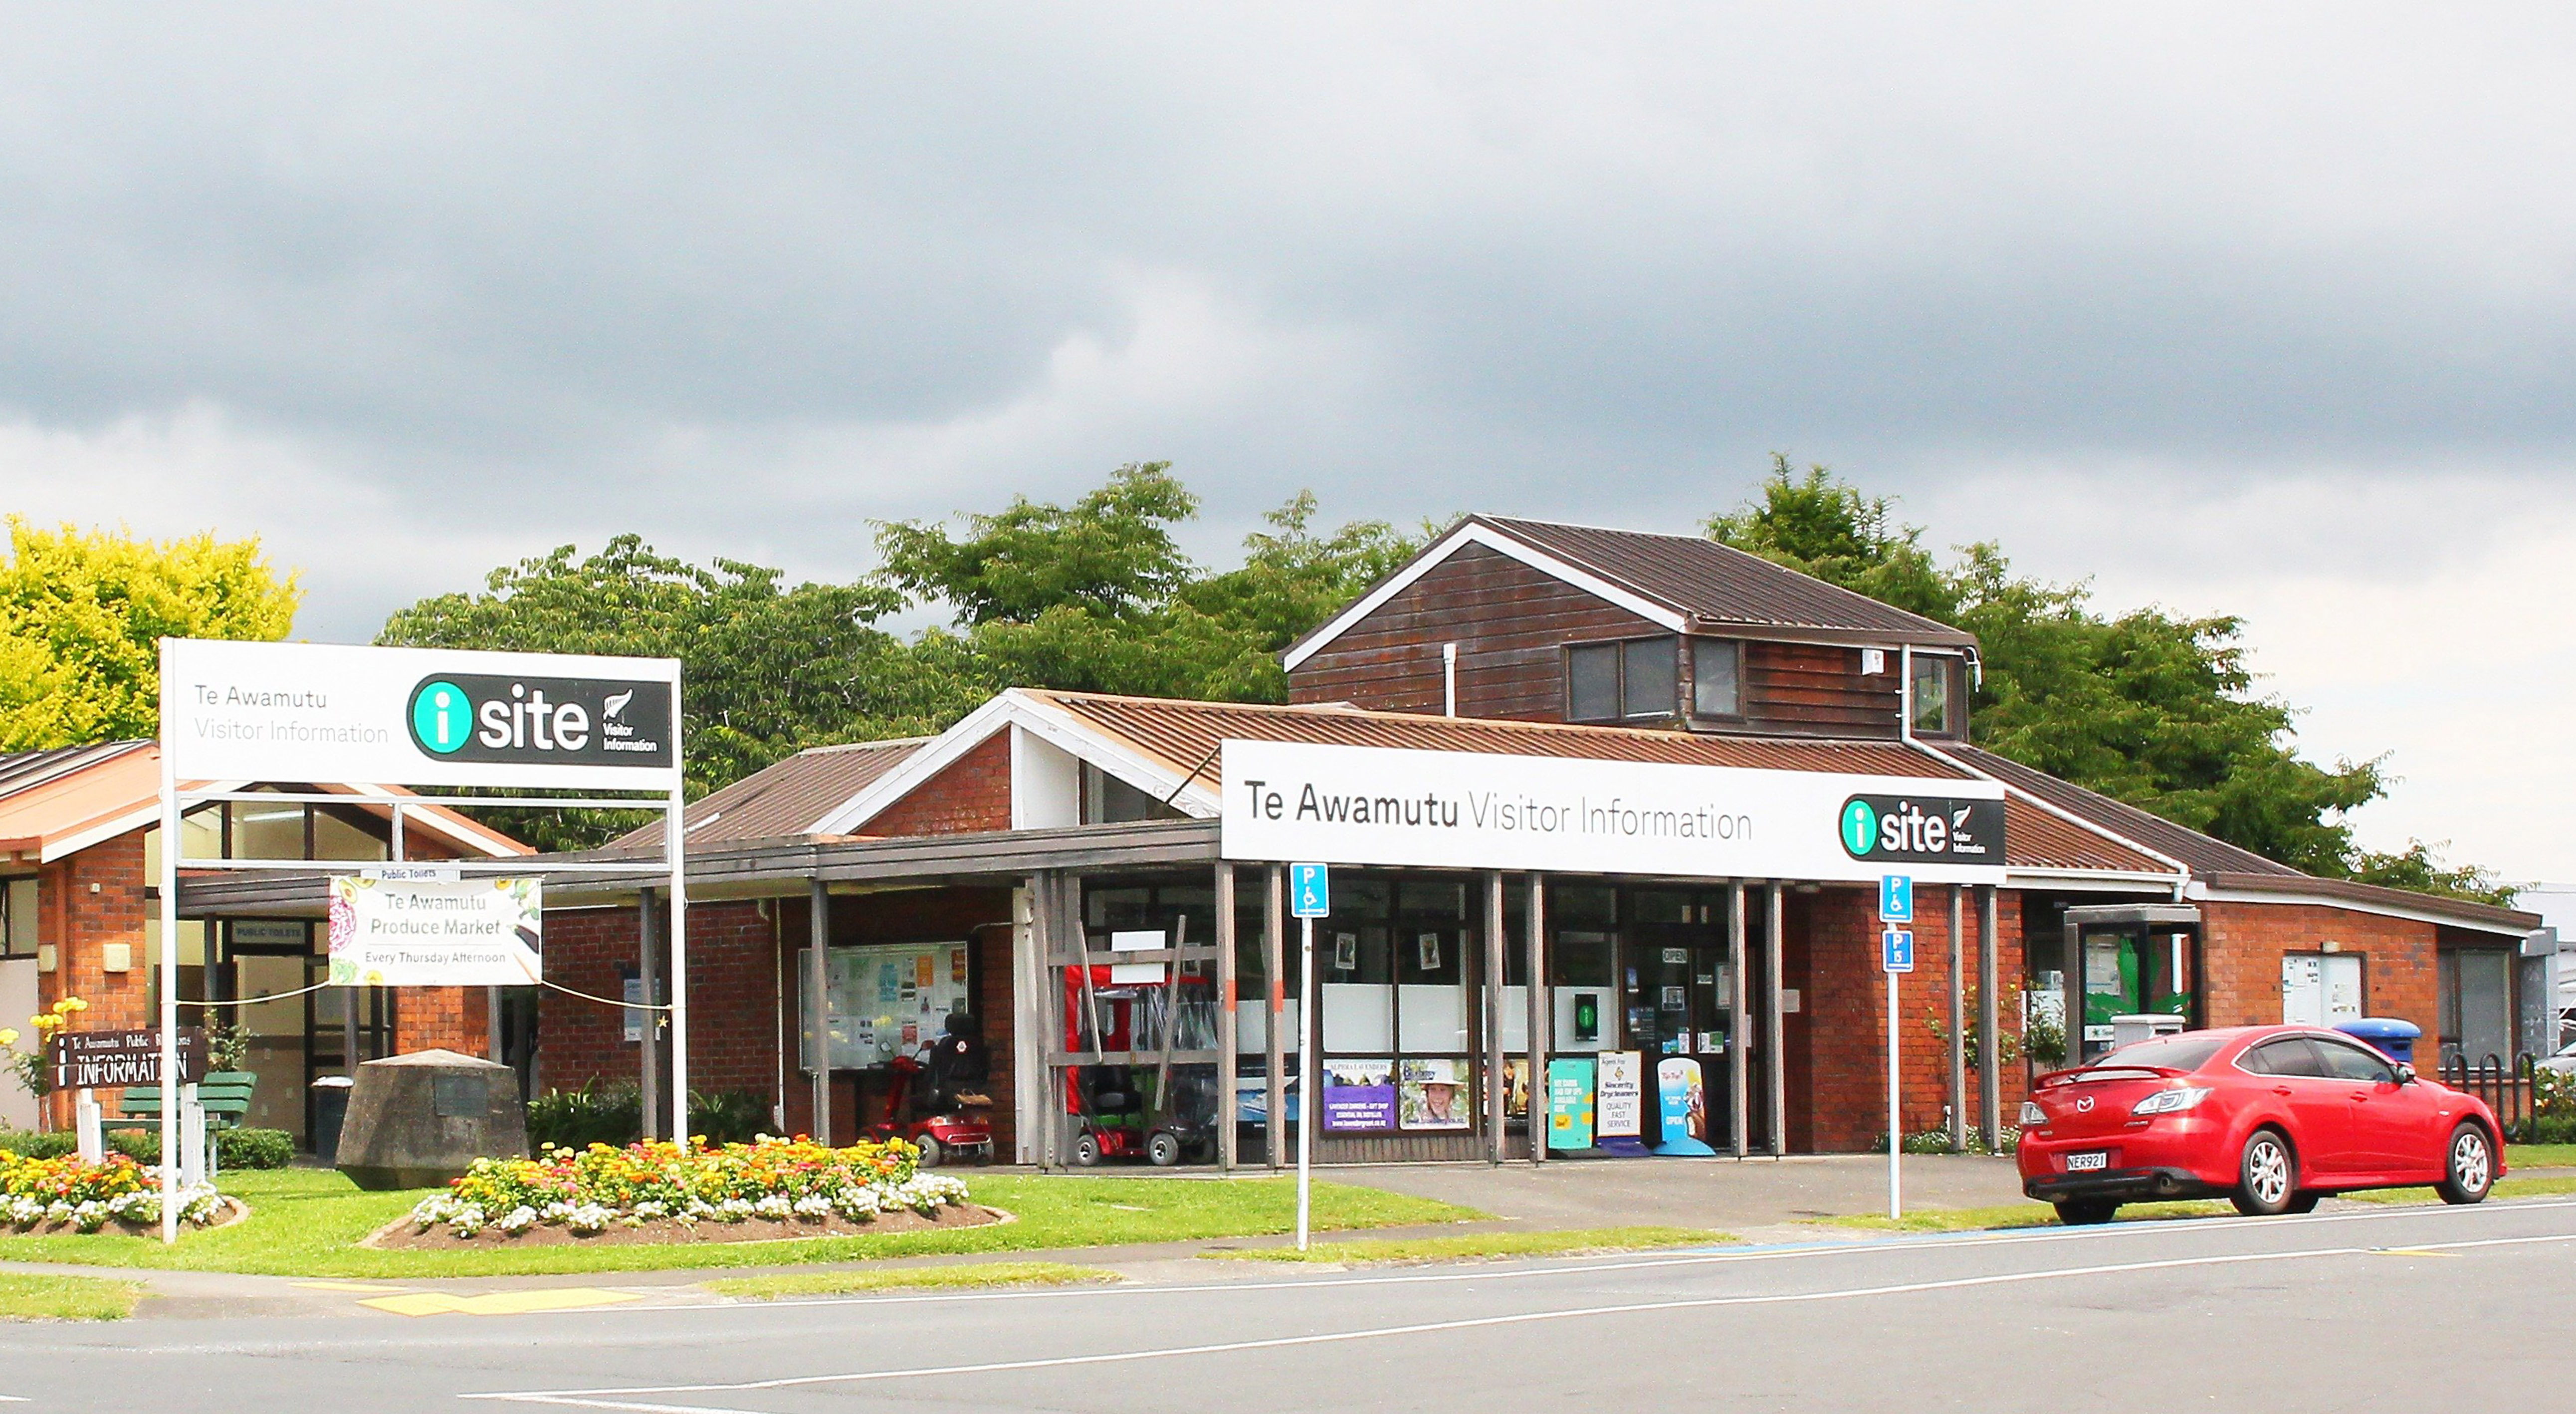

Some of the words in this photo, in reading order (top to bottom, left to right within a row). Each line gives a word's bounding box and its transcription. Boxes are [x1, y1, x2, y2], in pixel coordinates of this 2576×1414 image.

[195, 685, 218, 705] Te
[226, 686, 327, 708] Awamutu
[195, 717, 263, 740] Visitor
[271, 720, 389, 743] Information
[603, 723, 634, 737] Visitor
[603, 737, 657, 752] Information
[1244, 780, 1283, 820] Te
[1296, 783, 1458, 827] Awamutu
[1469, 791, 1570, 832] Visitor
[1582, 796, 1752, 840] Information
[1953, 843, 1986, 854] Information
[382, 870, 407, 879] Public
[1303, 867, 1315, 884] P
[1891, 877, 1902, 892] P
[385, 893, 404, 910] Te
[409, 893, 486, 911] Awamutu
[371, 918, 438, 935] Produce
[444, 918, 501, 935] Market
[1893, 934, 1903, 949] P
[365, 952, 395, 965] Every
[399, 952, 448, 965] Thursday
[452, 952, 506, 963] Afternoon
[71, 1036, 81, 1049] Te
[84, 1036, 120, 1049] Awamutu
[126, 1034, 149, 1048] Public
[76, 1051, 188, 1085] INFORMATN
[2067, 1155, 2104, 1169] NER921
